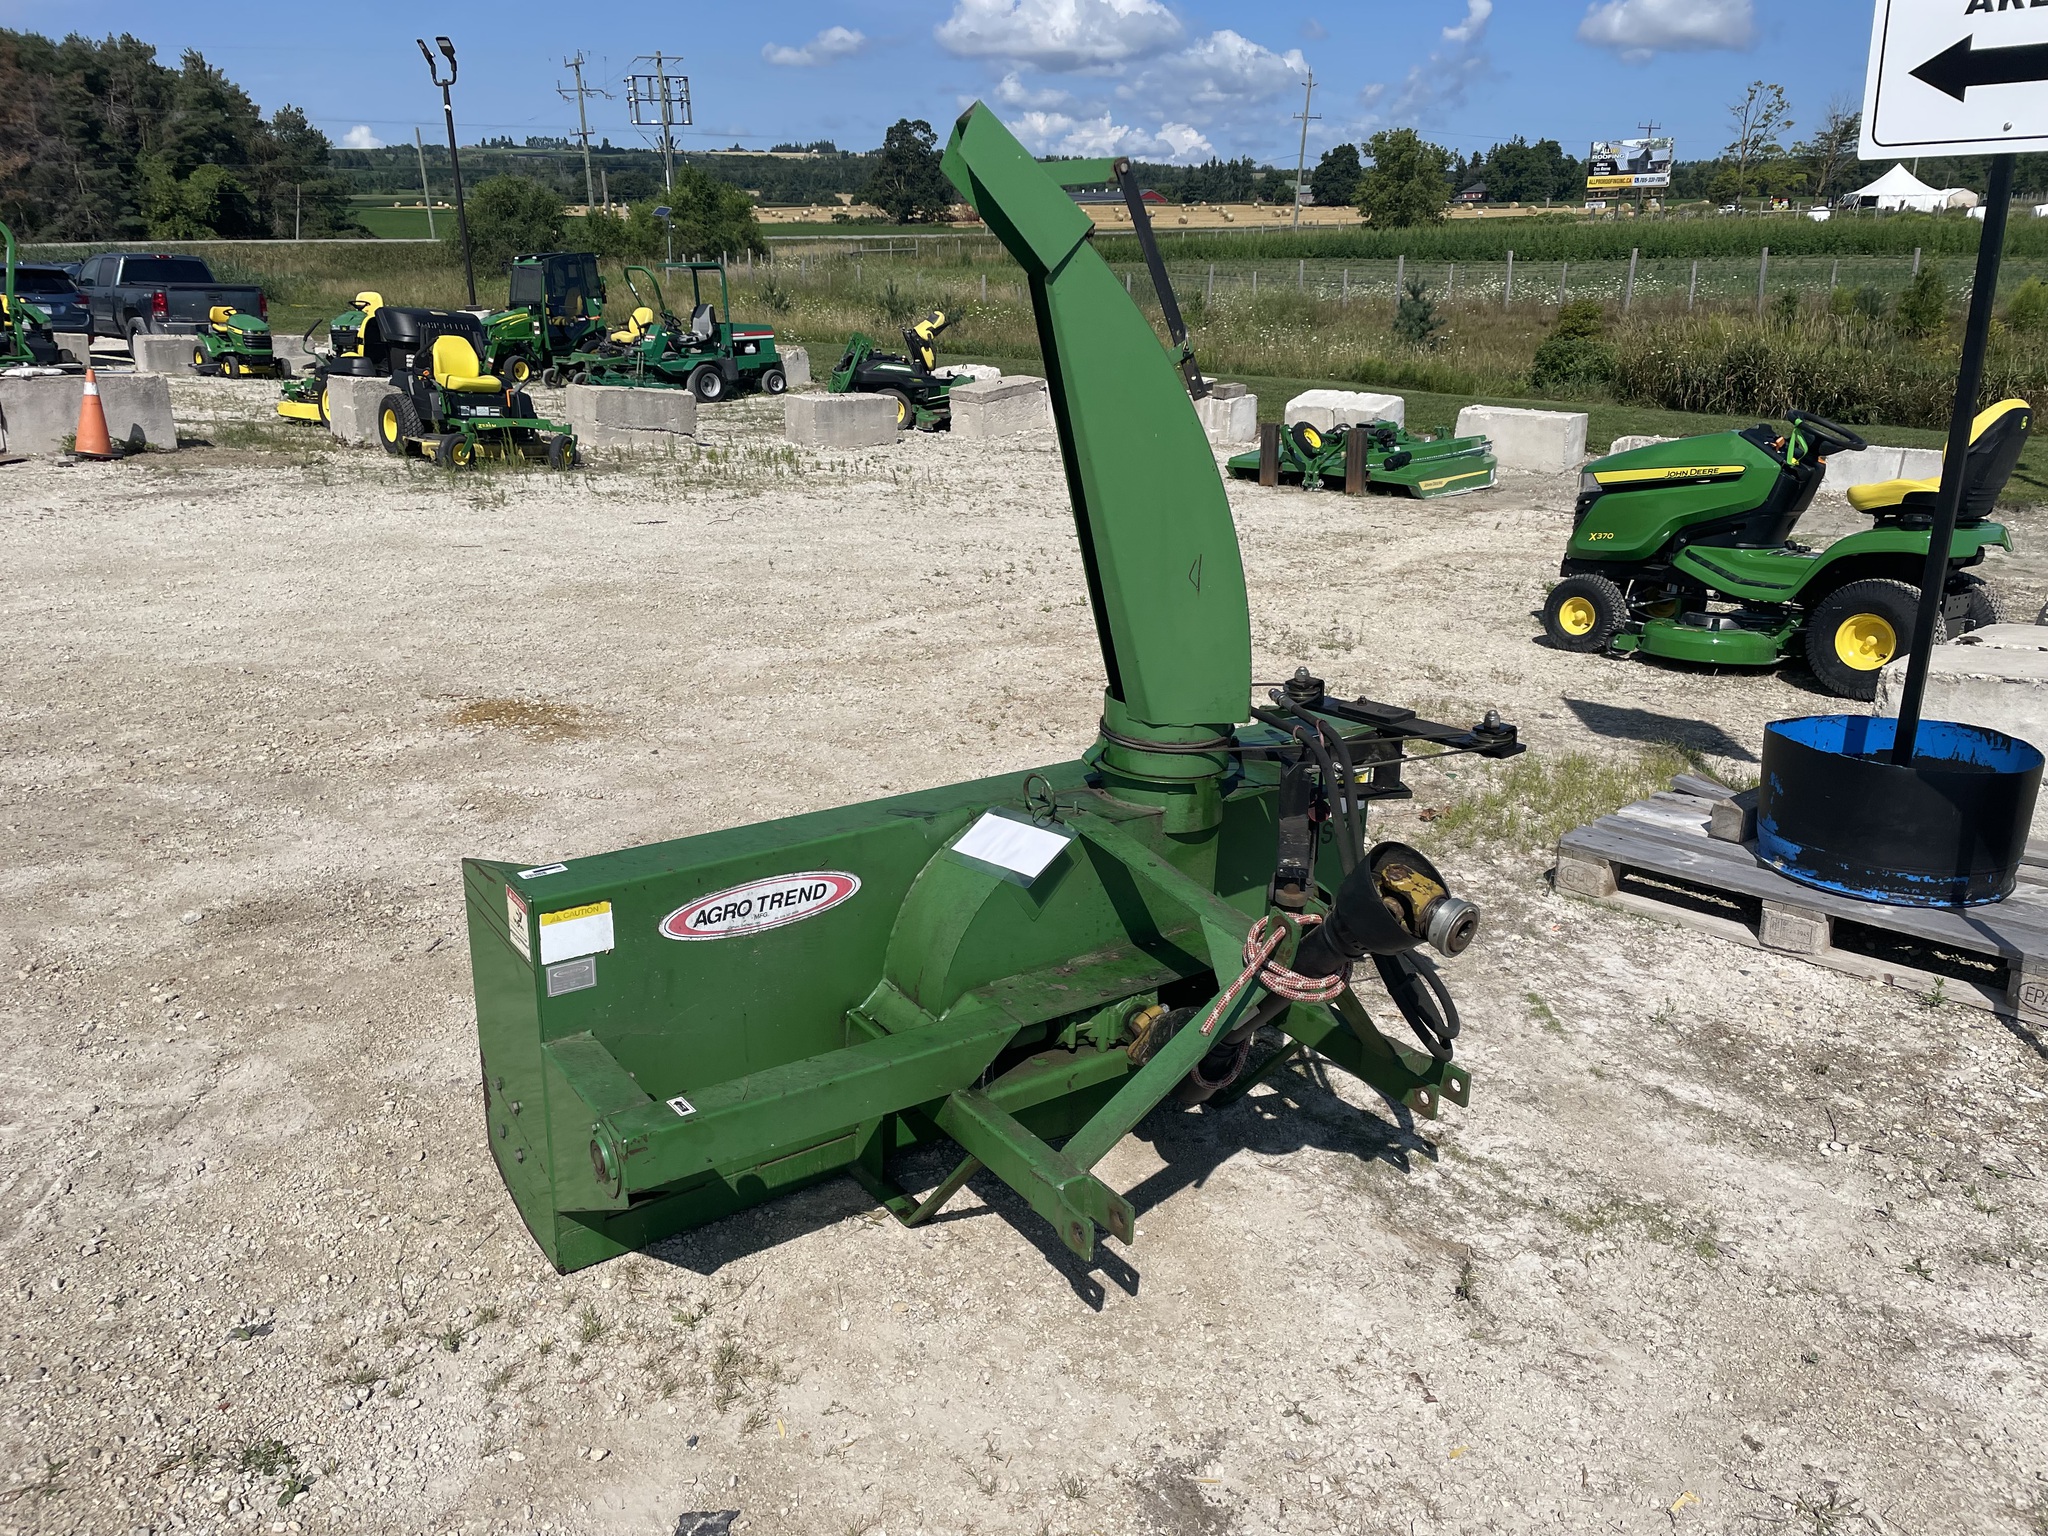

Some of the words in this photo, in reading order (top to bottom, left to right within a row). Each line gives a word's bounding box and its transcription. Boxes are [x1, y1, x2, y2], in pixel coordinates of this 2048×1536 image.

[1664, 469, 1689, 478] JOHN
[1689, 467, 1720, 477] DEERE
[1588, 532, 1615, 541] X370
[563, 905, 599, 919] CAUTION
[692, 899, 753, 929] AGRO
[757, 883, 828, 913] TREND
